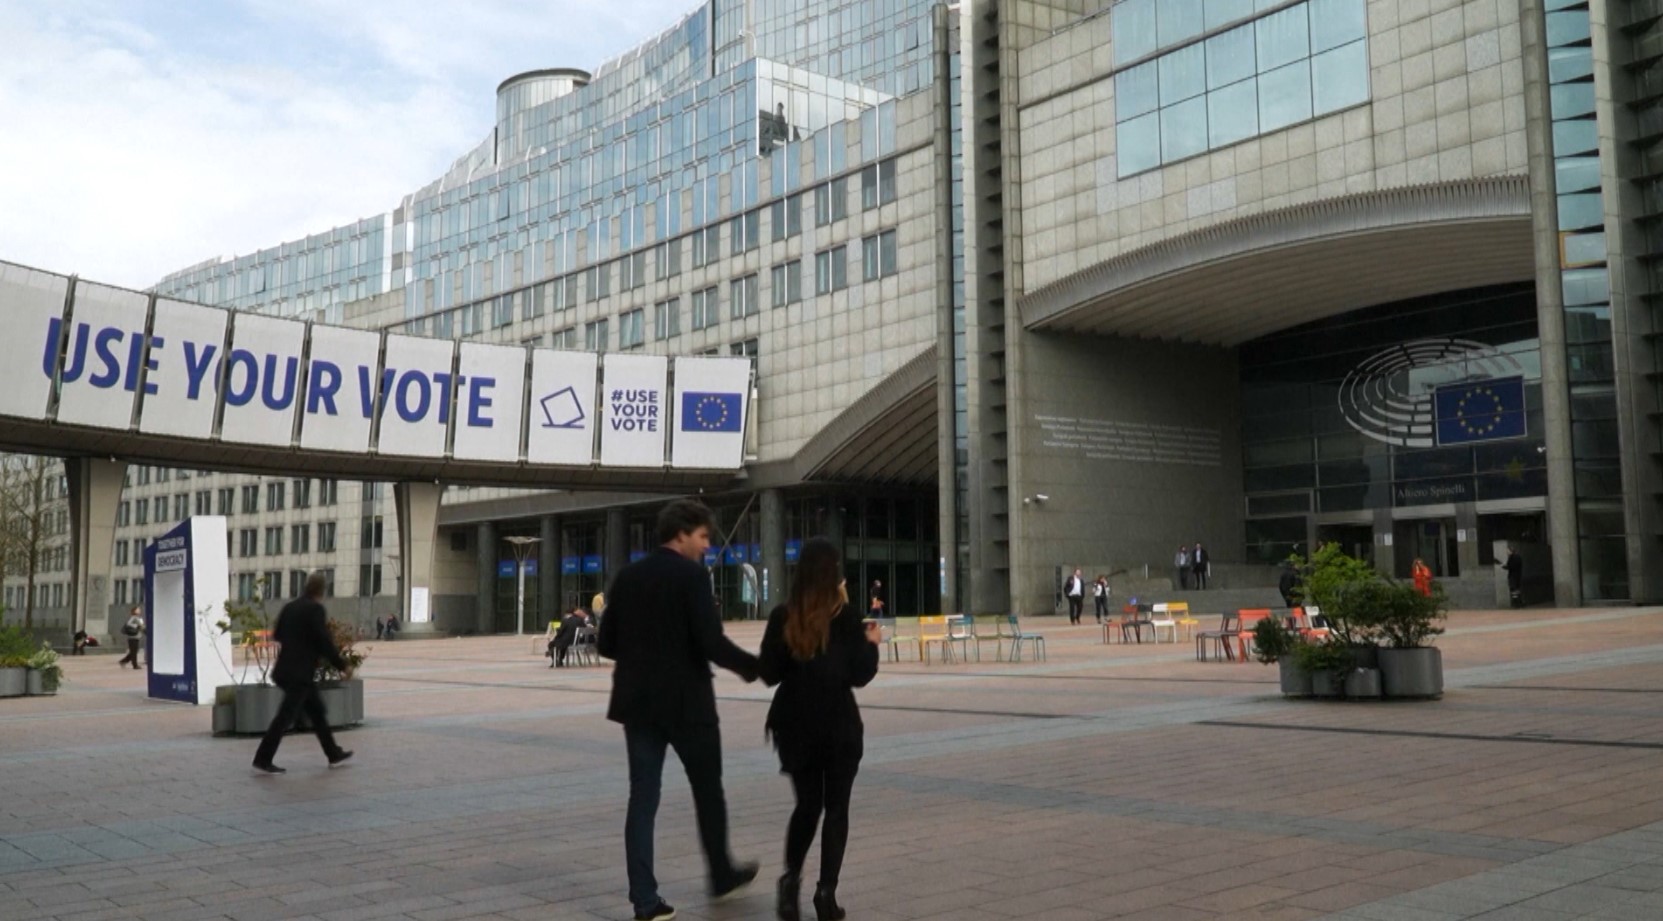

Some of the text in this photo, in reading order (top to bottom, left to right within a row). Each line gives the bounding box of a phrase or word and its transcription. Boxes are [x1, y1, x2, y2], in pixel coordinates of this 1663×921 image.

[43, 317, 496, 428] USE YOUR VOTE
[611, 389, 658, 403] #USE
[611, 403, 659, 418] YOUR
[611, 417, 657, 432] VOTE
[158, 553, 184, 567] DEMOCRACY
